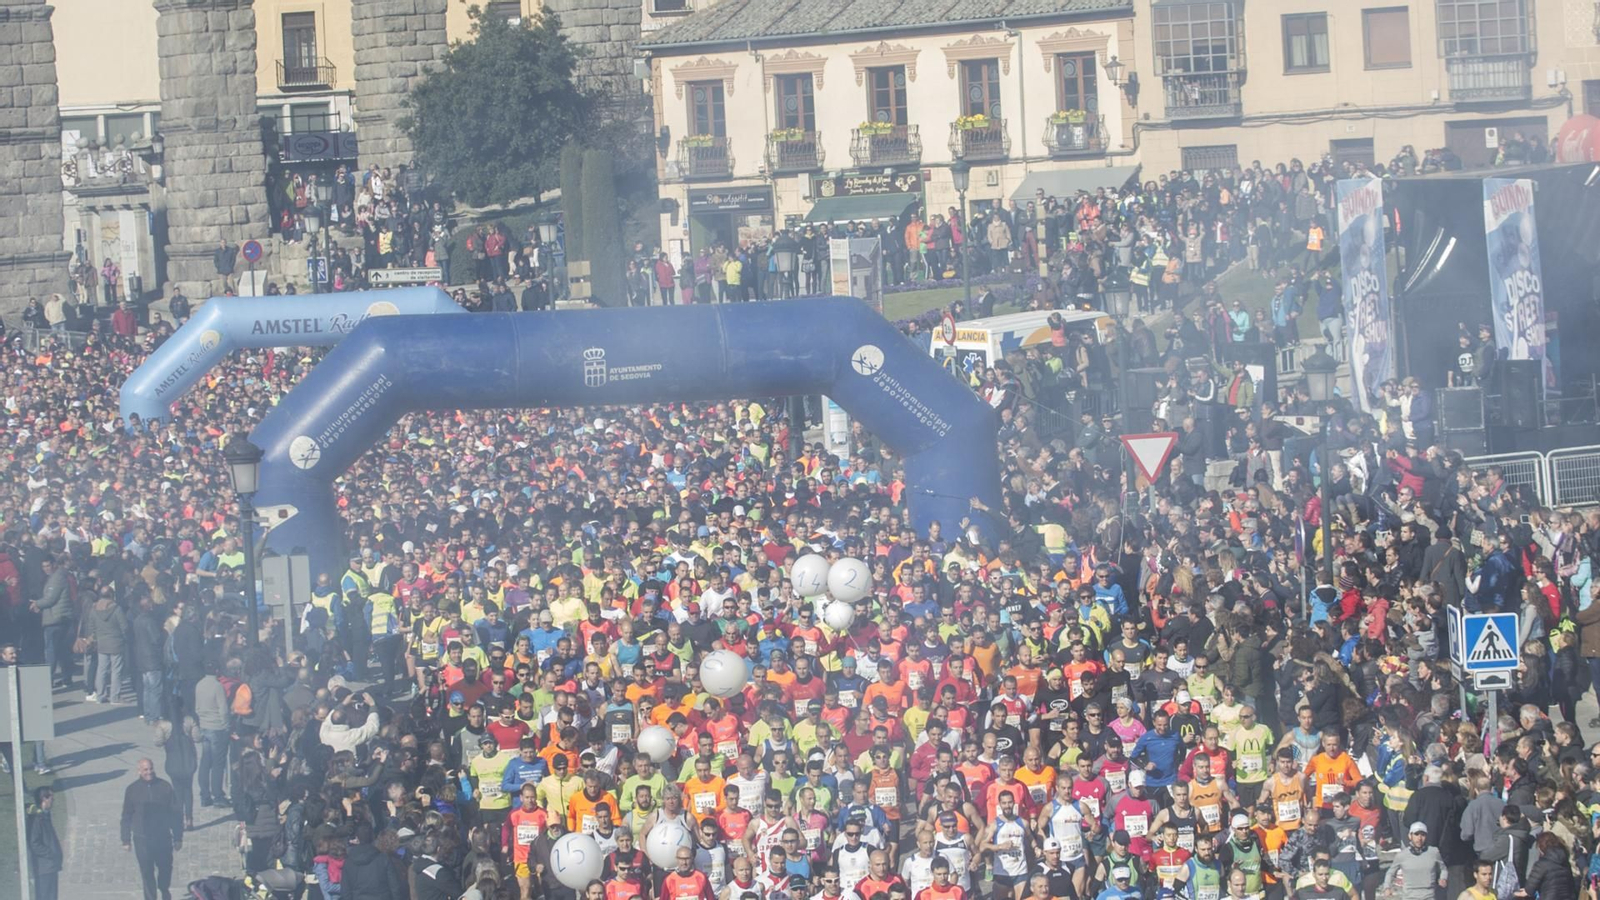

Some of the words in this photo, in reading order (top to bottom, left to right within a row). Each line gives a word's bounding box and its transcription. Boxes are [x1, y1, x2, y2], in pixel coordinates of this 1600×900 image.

[1350, 270, 1380, 305] DISCO
[1504, 270, 1540, 306] DISCO
[252, 318, 323, 334] AMSTEL
[1504, 294, 1540, 332] STREET
[154, 365, 191, 397] AMSTEL
[609, 363, 663, 375] AYUNTAMIENTO
[621, 372, 651, 380] SEGOVIA
[873, 376, 945, 437] deportessegovia
[878, 369, 952, 431] institutomunicipal
[797, 570, 820, 593] 14
[701, 800, 715, 808] 1512
